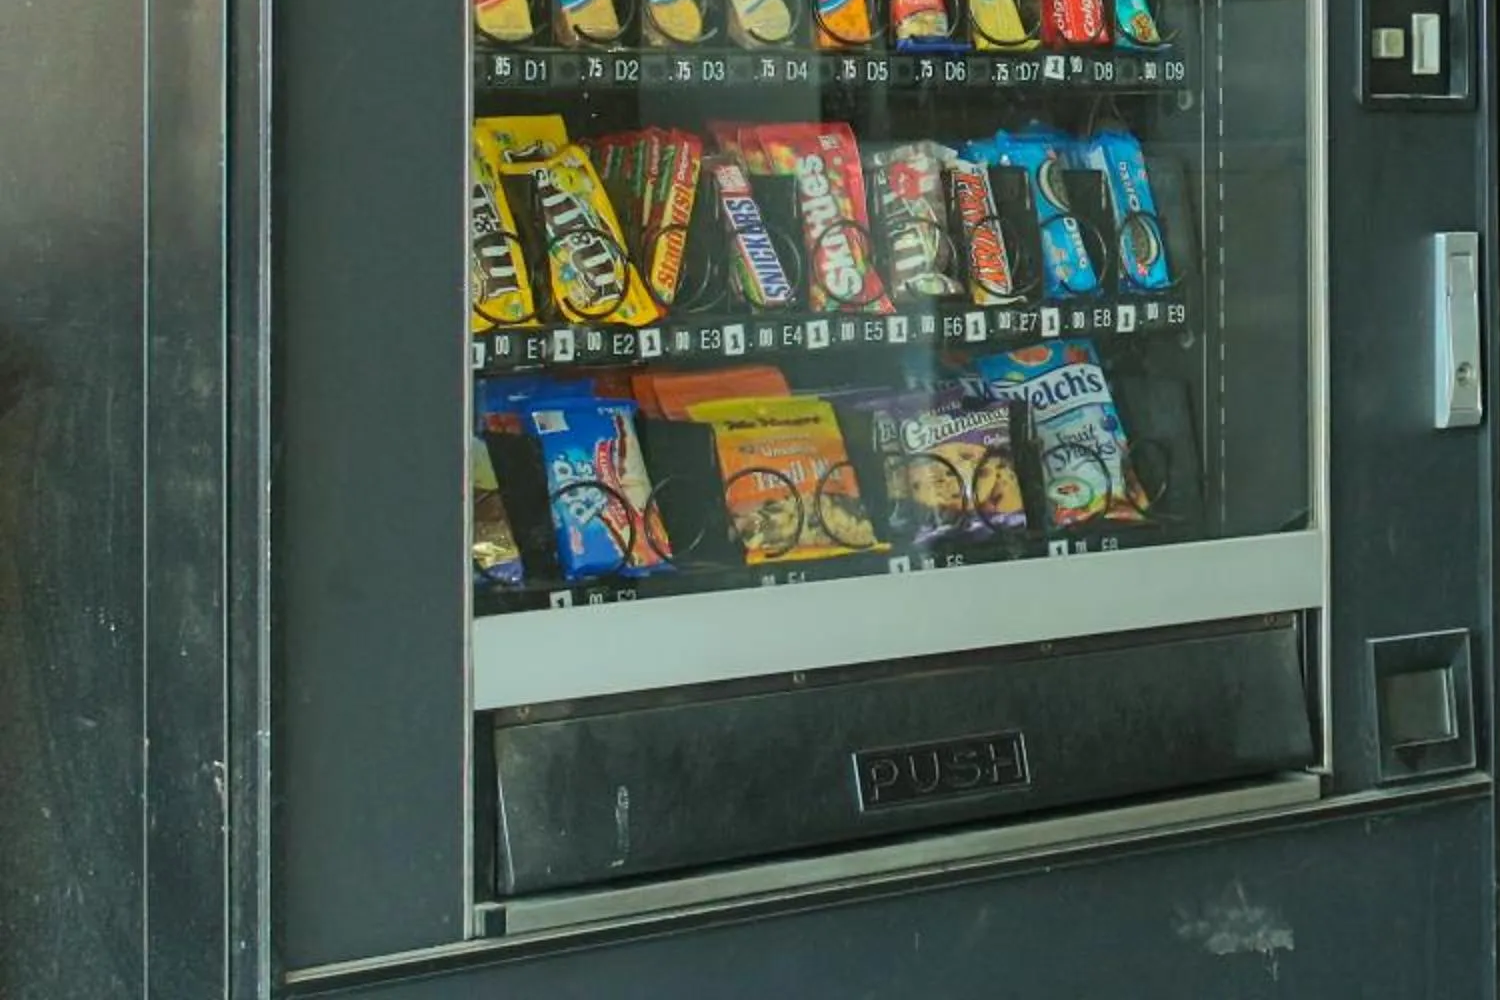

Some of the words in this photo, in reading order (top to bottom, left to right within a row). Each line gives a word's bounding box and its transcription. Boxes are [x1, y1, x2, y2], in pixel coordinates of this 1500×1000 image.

[487, 57, 511, 81] .85
[525, 61, 547, 81] D1
[581, 57, 603, 81] .75
[615, 61, 639, 81] D2
[668, 61, 692, 81] .75
[703, 60, 725, 81] D3
[754, 58, 775, 81] .75
[786, 61, 808, 81] D4
[836, 59, 857, 81] .75
[867, 61, 889, 82] D5
[915, 59, 933, 81] .75
[945, 61, 966, 81] D6
[1021, 62, 1040, 81] D7
[1094, 61, 1114, 81] D8
[1165, 62, 1185, 81] D9
[800, 155, 863, 298] Skittles
[725, 199, 791, 299] SNICKERS
[1020, 312, 1039, 332] E7
[1045, 311, 1085, 332] 1.00
[1093, 309, 1112, 328] E8
[1167, 304, 1185, 324] E9
[729, 328, 773, 350] 1.00
[783, 326, 803, 345] E4
[864, 321, 884, 340] E5
[943, 318, 963, 337] E6
[527, 338, 547, 359] E1
[558, 331, 602, 357] 1.00
[612, 334, 635, 356] E2
[644, 331, 689, 353] 1.00
[700, 329, 721, 350] E3
[1055, 424, 1096, 449] Fruit
[868, 739, 1023, 801] PUSH
